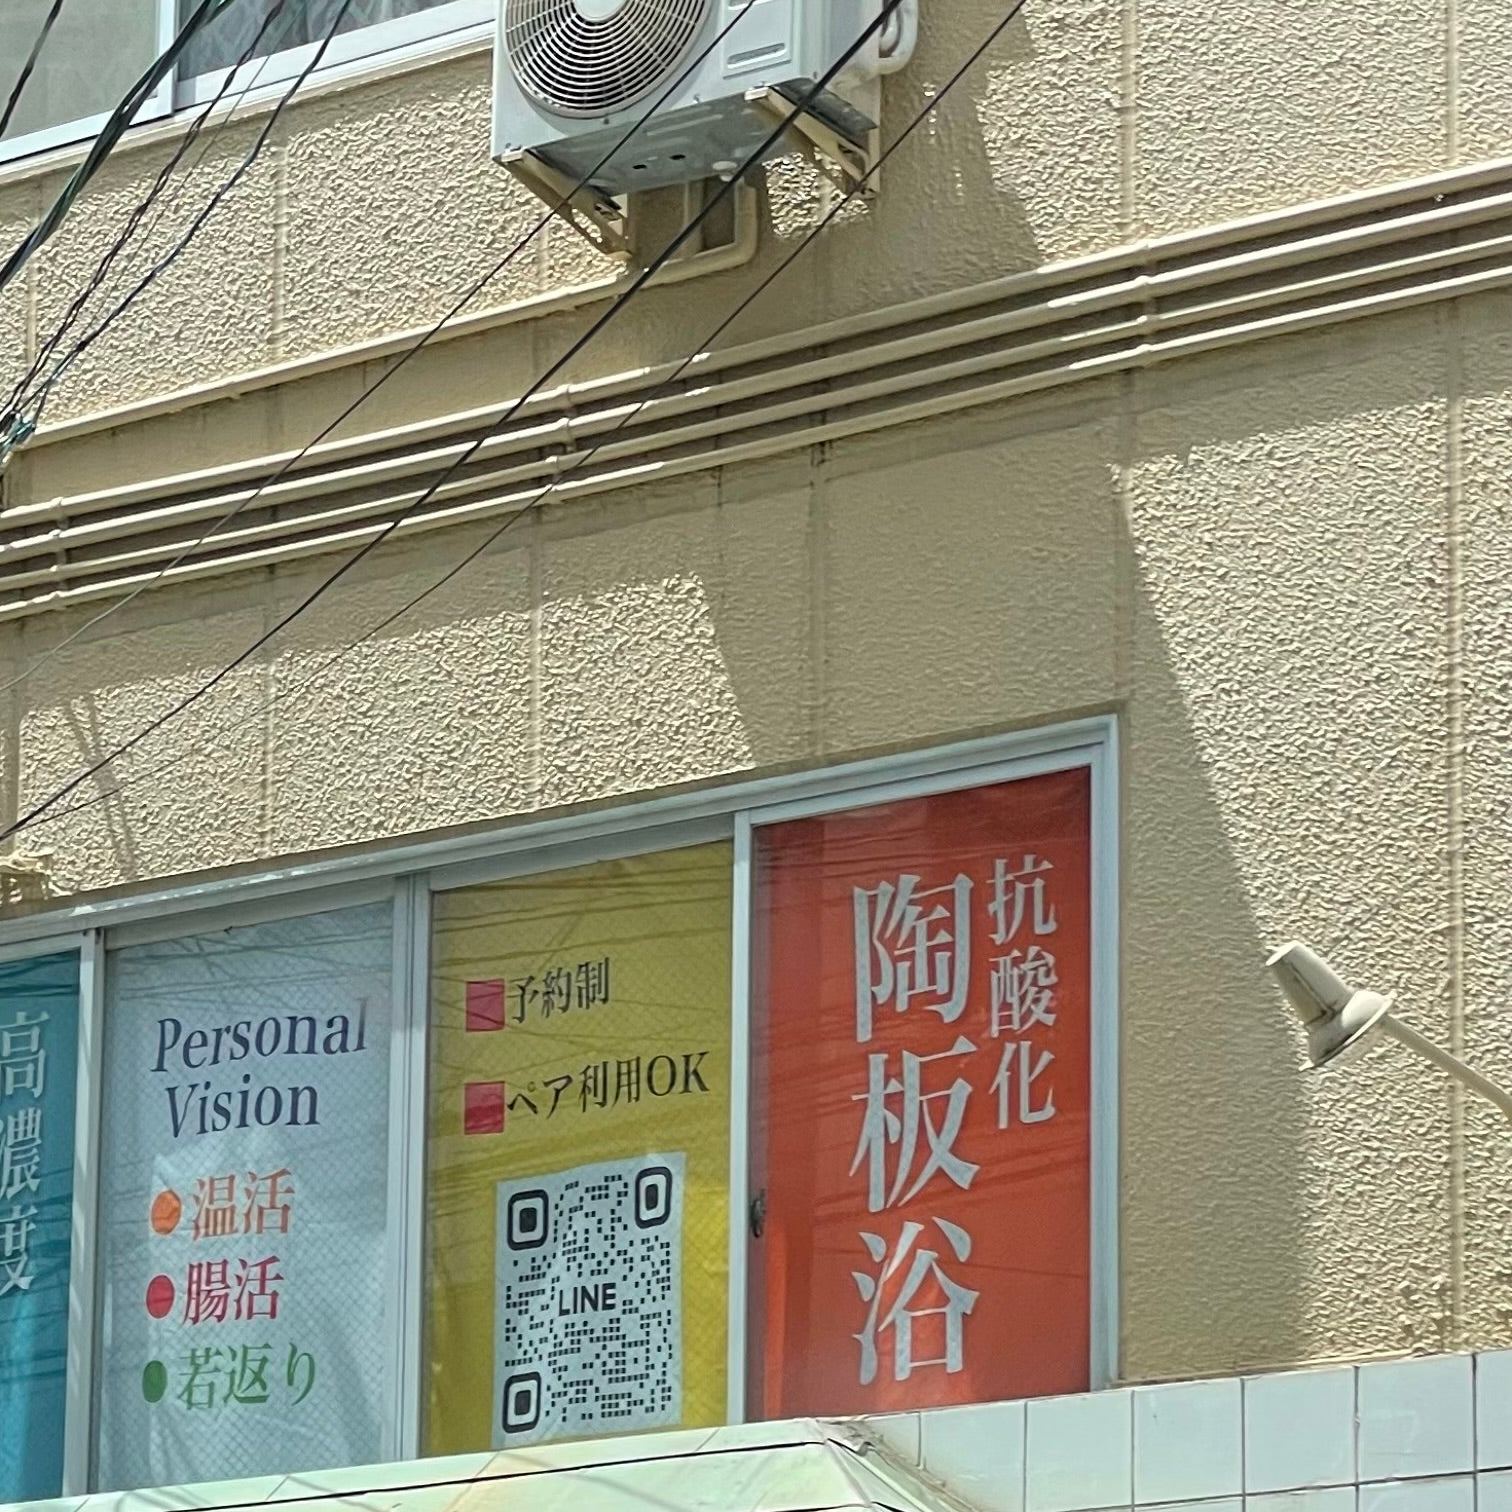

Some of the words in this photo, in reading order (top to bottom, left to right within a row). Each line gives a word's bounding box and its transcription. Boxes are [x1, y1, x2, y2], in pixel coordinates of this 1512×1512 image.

[508, 957, 611, 1024] 予約制
[987, 854, 1058, 1130] 抗酸化
[150, 998, 369, 1073] Personal
[164, 1073, 321, 1138] Vision
[506, 1051, 711, 1119] ペア利用OK
[849, 873, 981, 1386] 陶板浴
[191, 1168, 295, 1241] 温活
[182, 1255, 284, 1326] 腸活
[558, 1282, 618, 1317] LINE
[177, 1342, 317, 1410] 若返り
